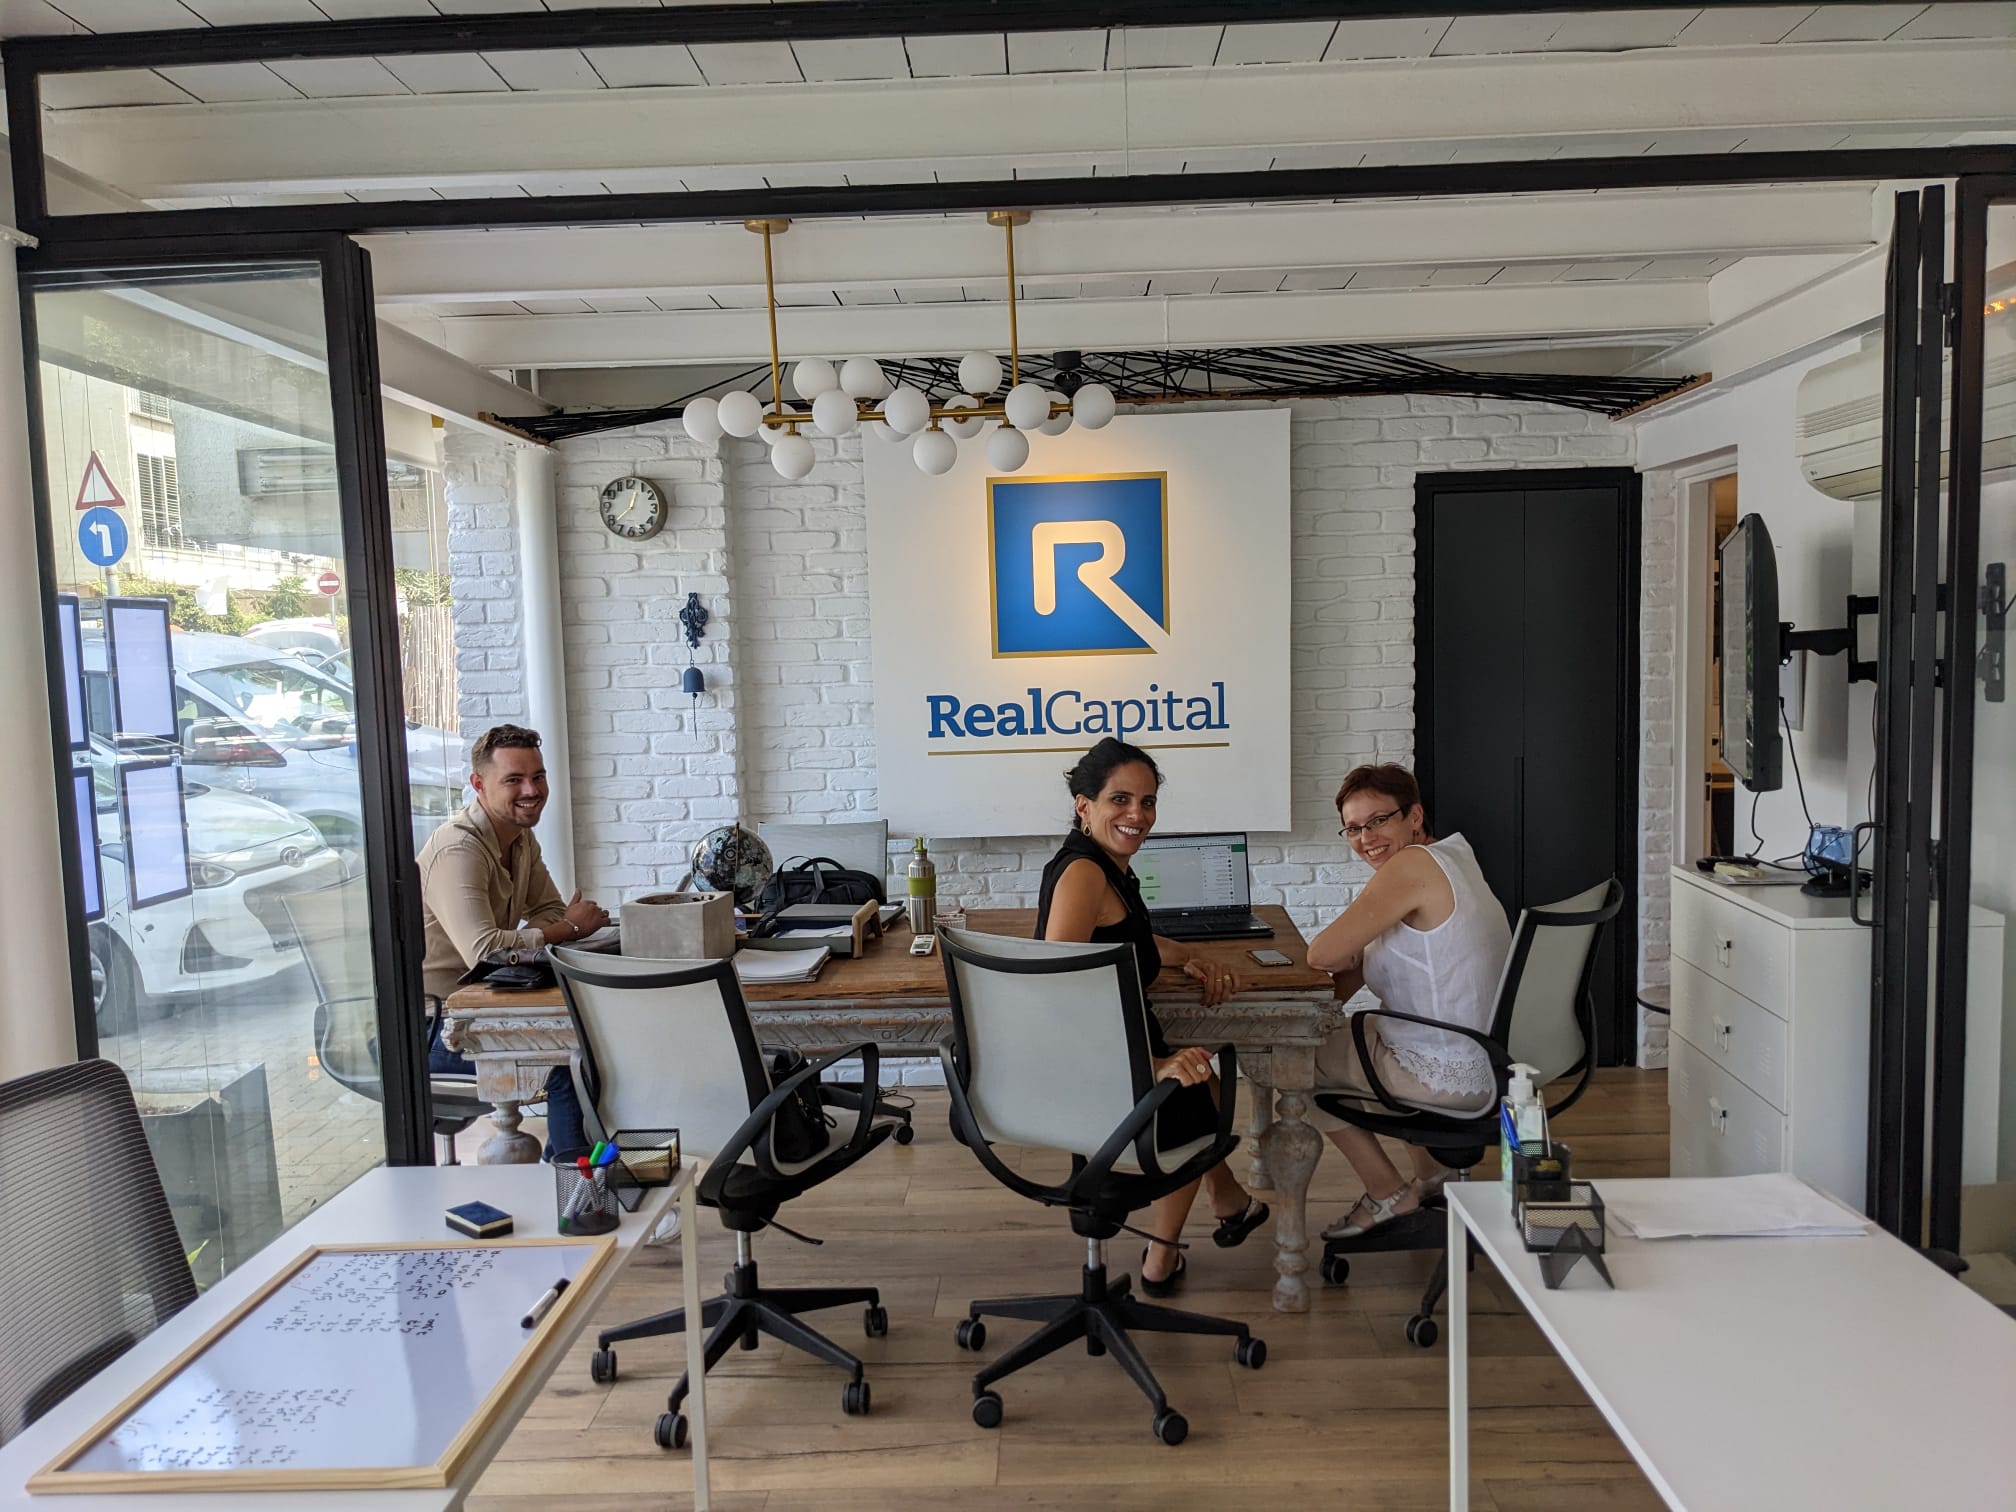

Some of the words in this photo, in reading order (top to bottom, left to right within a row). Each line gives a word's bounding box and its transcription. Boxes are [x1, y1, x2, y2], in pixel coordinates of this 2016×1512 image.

[626, 480, 636, 489] 12
[647, 490, 656, 500] 2
[603, 502, 611, 513] 9
[650, 503, 657, 514] 3
[608, 515, 615, 526] 8
[646, 516, 654, 526] 4
[617, 524, 624, 535] 7
[627, 527, 635, 537] 6
[639, 524, 646, 535] 5
[1032, 520, 1170, 654] R
[926, 682, 1229, 741] RealCapital
